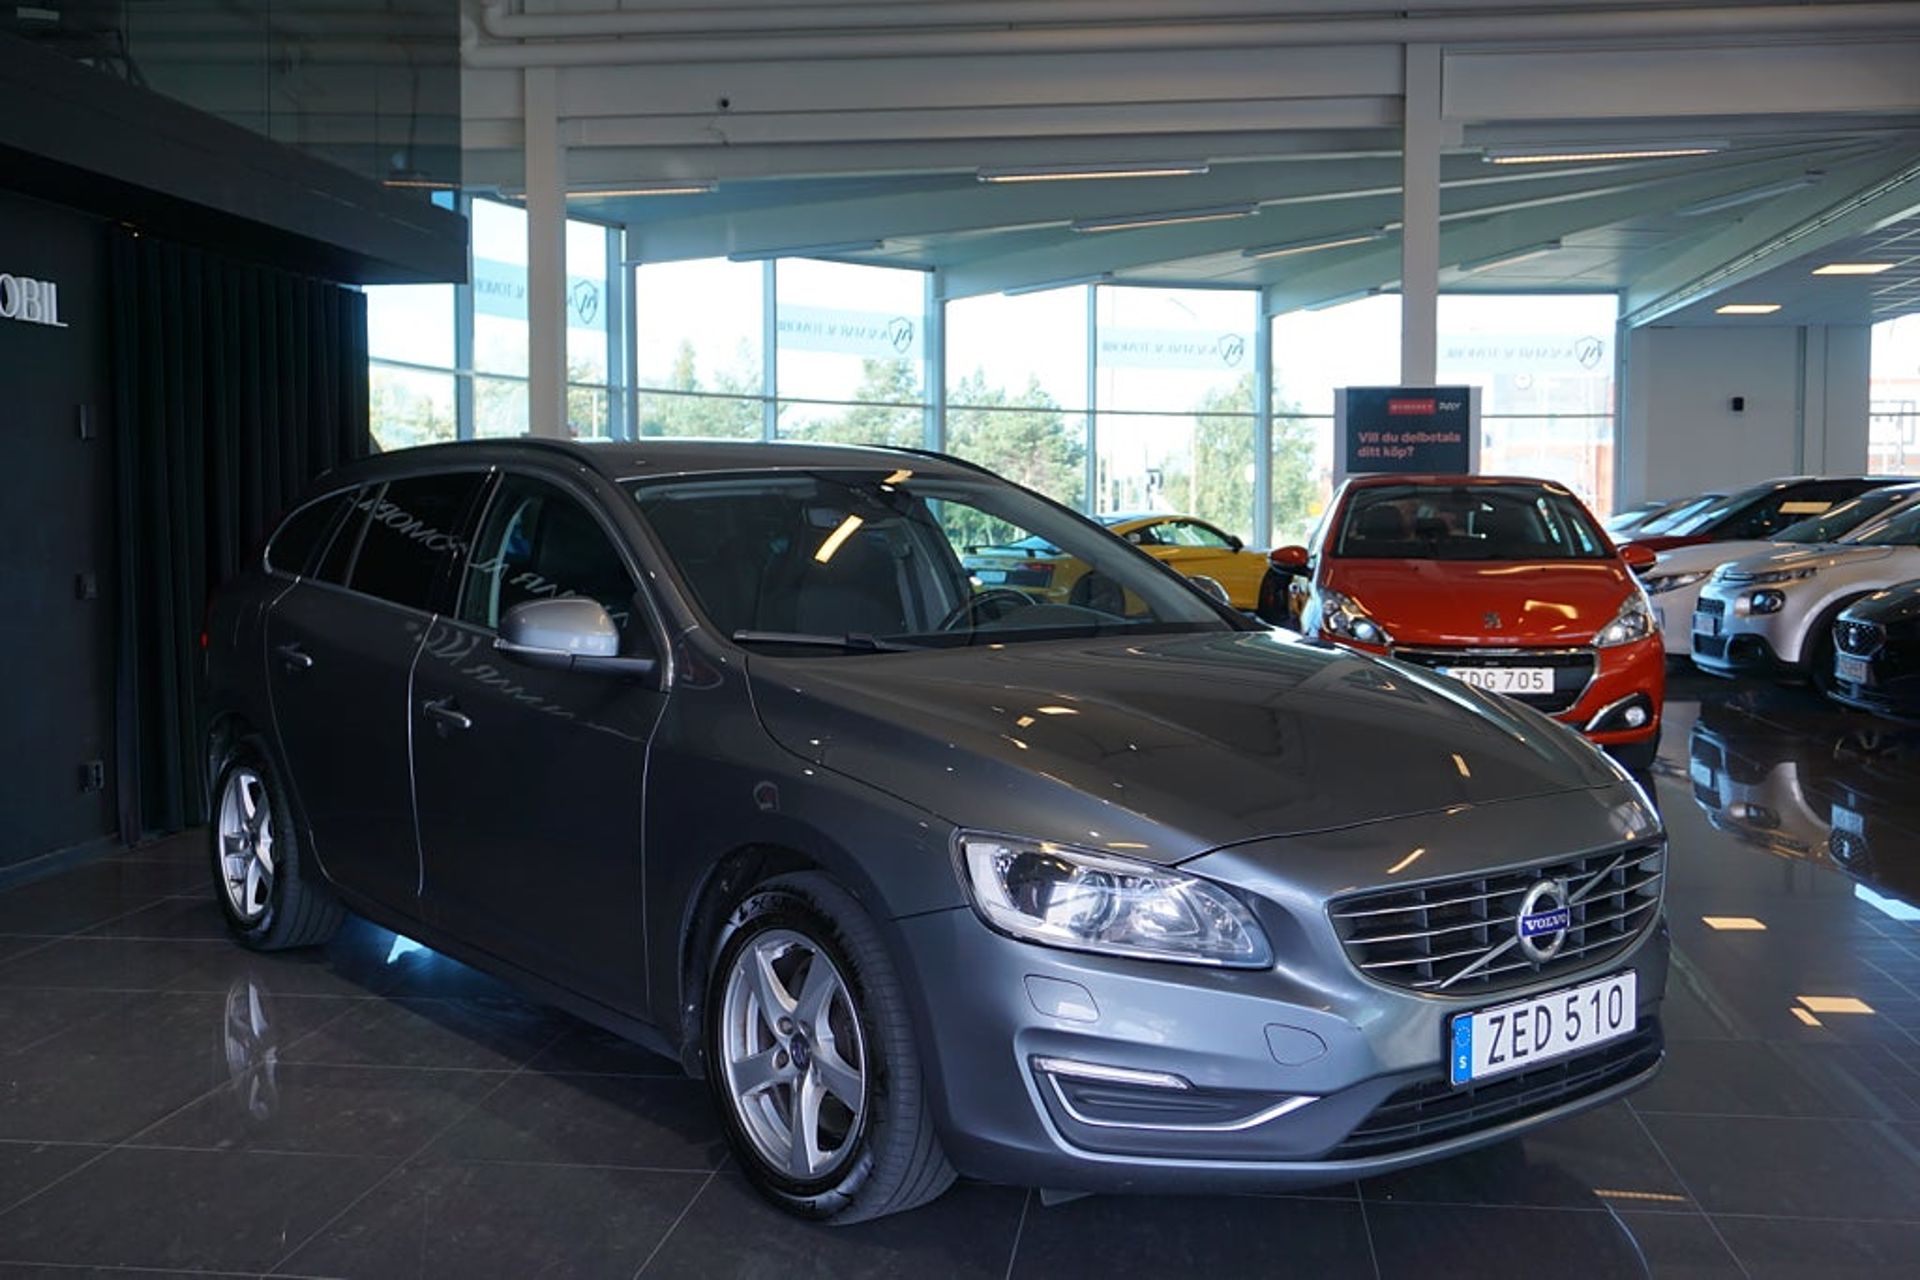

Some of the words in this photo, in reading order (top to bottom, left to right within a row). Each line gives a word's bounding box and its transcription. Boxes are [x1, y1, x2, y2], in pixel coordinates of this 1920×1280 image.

[1357, 432, 1379, 443] Vill
[1381, 432, 1399, 443] du
[1401, 432, 1461, 443] delbetala
[1357, 446, 1380, 457] ditt
[1383, 446, 1415, 459] köp?
[1456, 671, 1496, 689] TDG
[1504, 671, 1544, 690] 705
[1525, 913, 1567, 931] VOLVO
[1458, 1055, 1467, 1070] S
[1488, 1005, 1552, 1065] ZED
[1565, 984, 1623, 1042] 510
